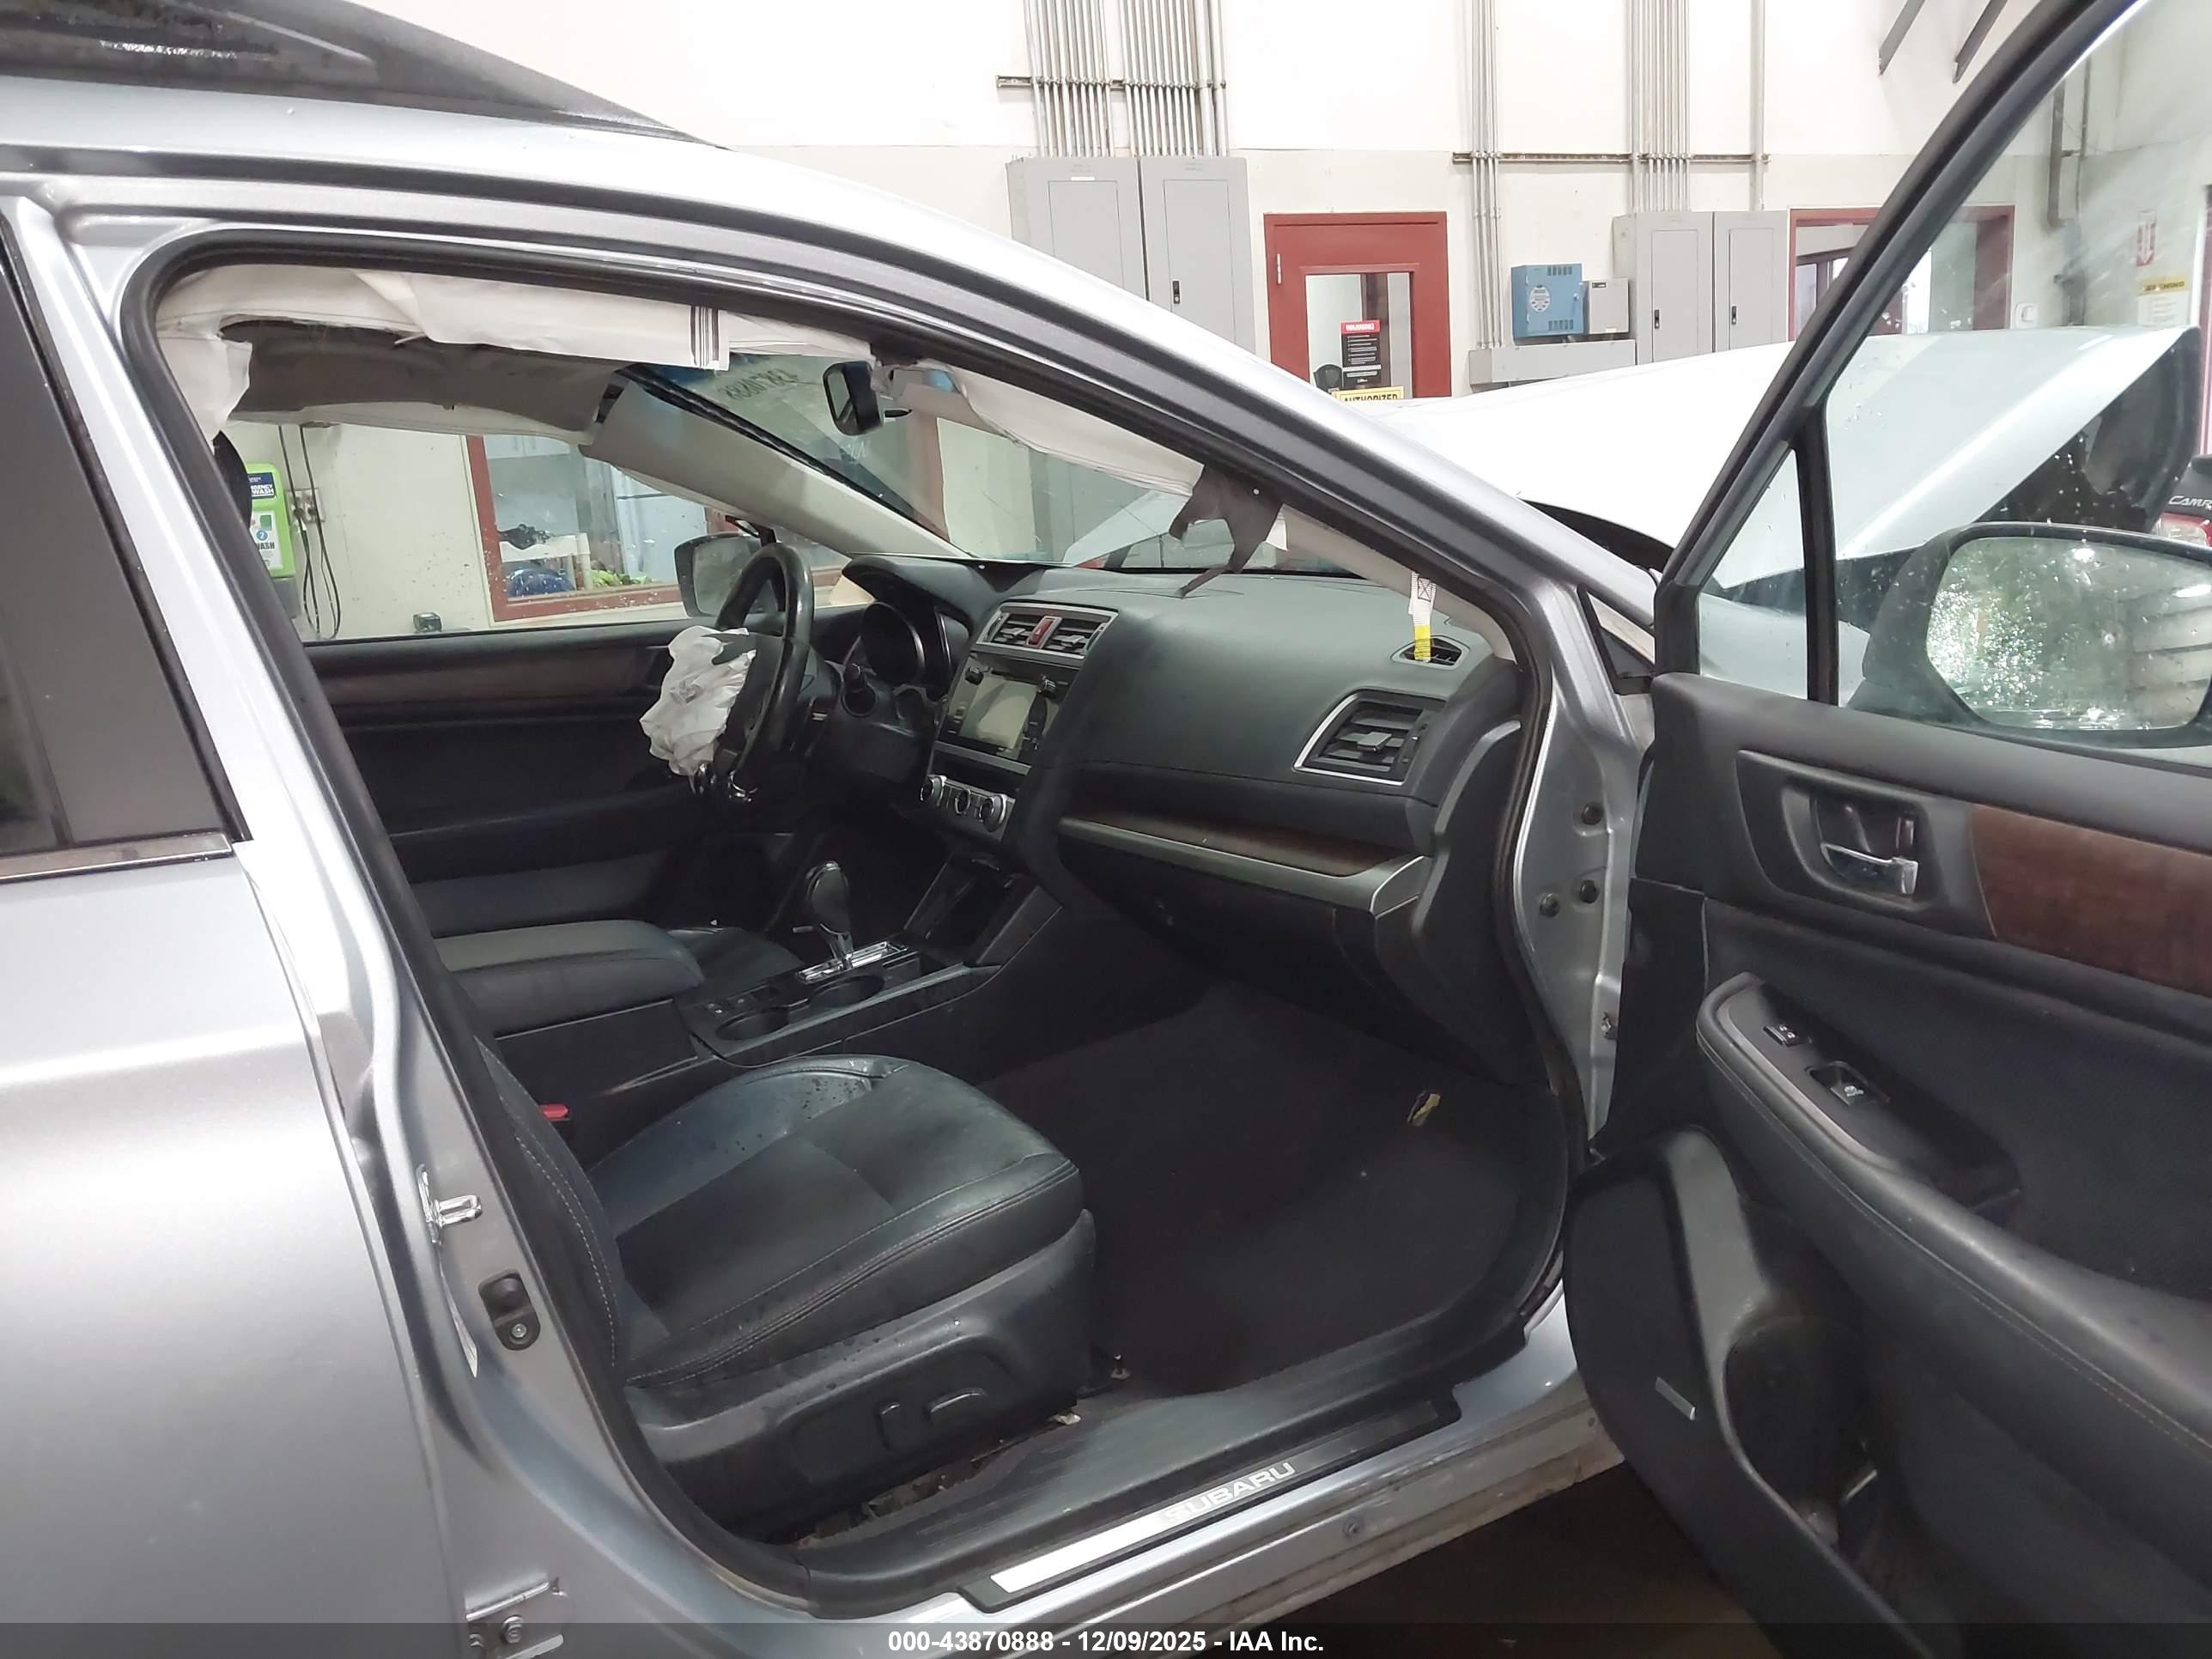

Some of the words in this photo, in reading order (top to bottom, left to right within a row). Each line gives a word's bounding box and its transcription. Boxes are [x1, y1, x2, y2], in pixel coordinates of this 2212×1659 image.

[1346, 323, 1375, 331] WARNING
[2168, 495, 2212, 508] CAMR
[1164, 1462, 1295, 1521] SUBARU
